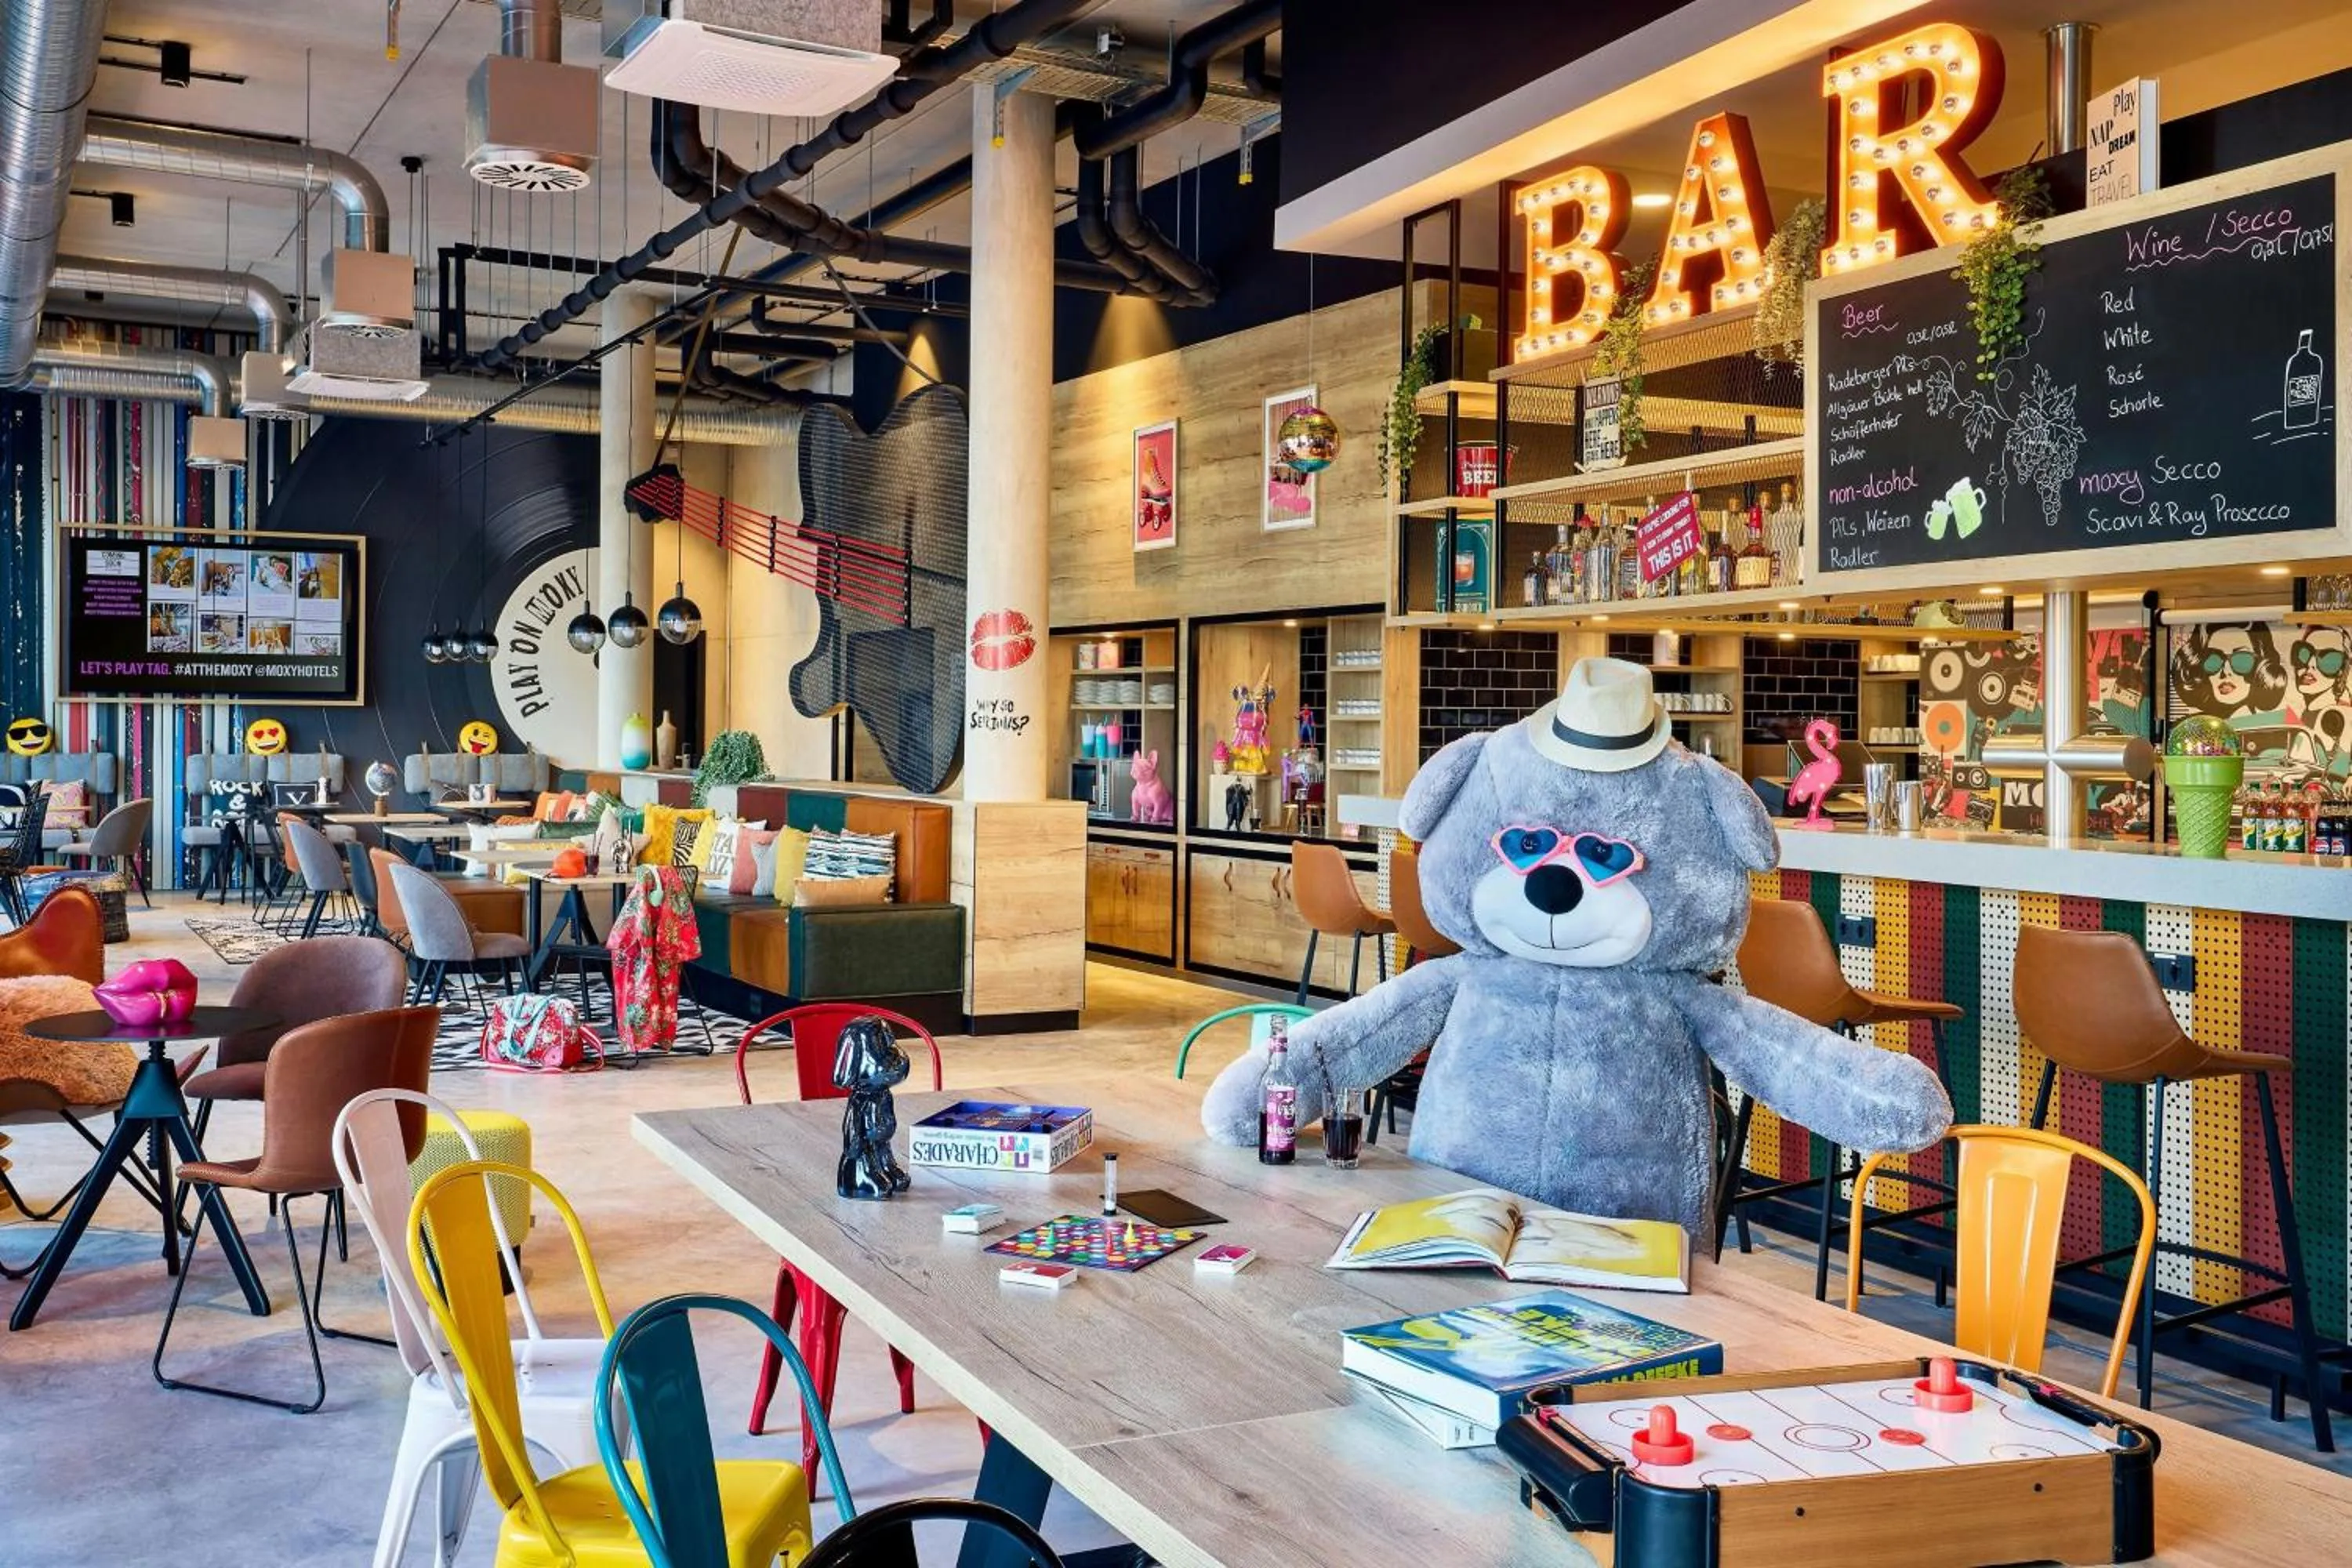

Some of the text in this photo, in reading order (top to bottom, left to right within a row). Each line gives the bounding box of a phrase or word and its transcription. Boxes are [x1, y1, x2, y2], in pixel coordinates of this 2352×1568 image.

[2113, 88, 2136, 118] Play
[2089, 119, 2114, 149] NAP
[2108, 129, 2136, 155] DREAM
[2089, 159, 2114, 183] EAT
[1514, 21, 2004, 364] BAR
[2090, 172, 2136, 206] TRAVEL
[2126, 225, 2183, 262] Wine
[2100, 285, 2136, 314] Red
[1842, 303, 1883, 328] Beer
[2103, 321, 2153, 350] White
[1828, 364, 1893, 391] Radeberger
[2107, 363, 2144, 385] Rosé
[2079, 455, 2221, 506] moxy Secco
[2086, 493, 2290, 535] Scavi & Ray Prosecco
[1648, 546, 1671, 575] THIS
[1671, 539, 1683, 559] IS
[1683, 530, 1693, 552] IT
[1830, 546, 1879, 568] Radler
[508, 565, 584, 719] PLAY ON MOXY
[80, 661, 339, 677] LET'S PLAY TAG. #ATTHEMOXY @MOXYHOTELS
[976, 699, 1014, 713] WHY SO
[970, 711, 1029, 736] SERIOUS?
[209, 779, 263, 797] ROCK
[229, 793, 246, 810] &
[913, 1141, 998, 1165] CHARADES
